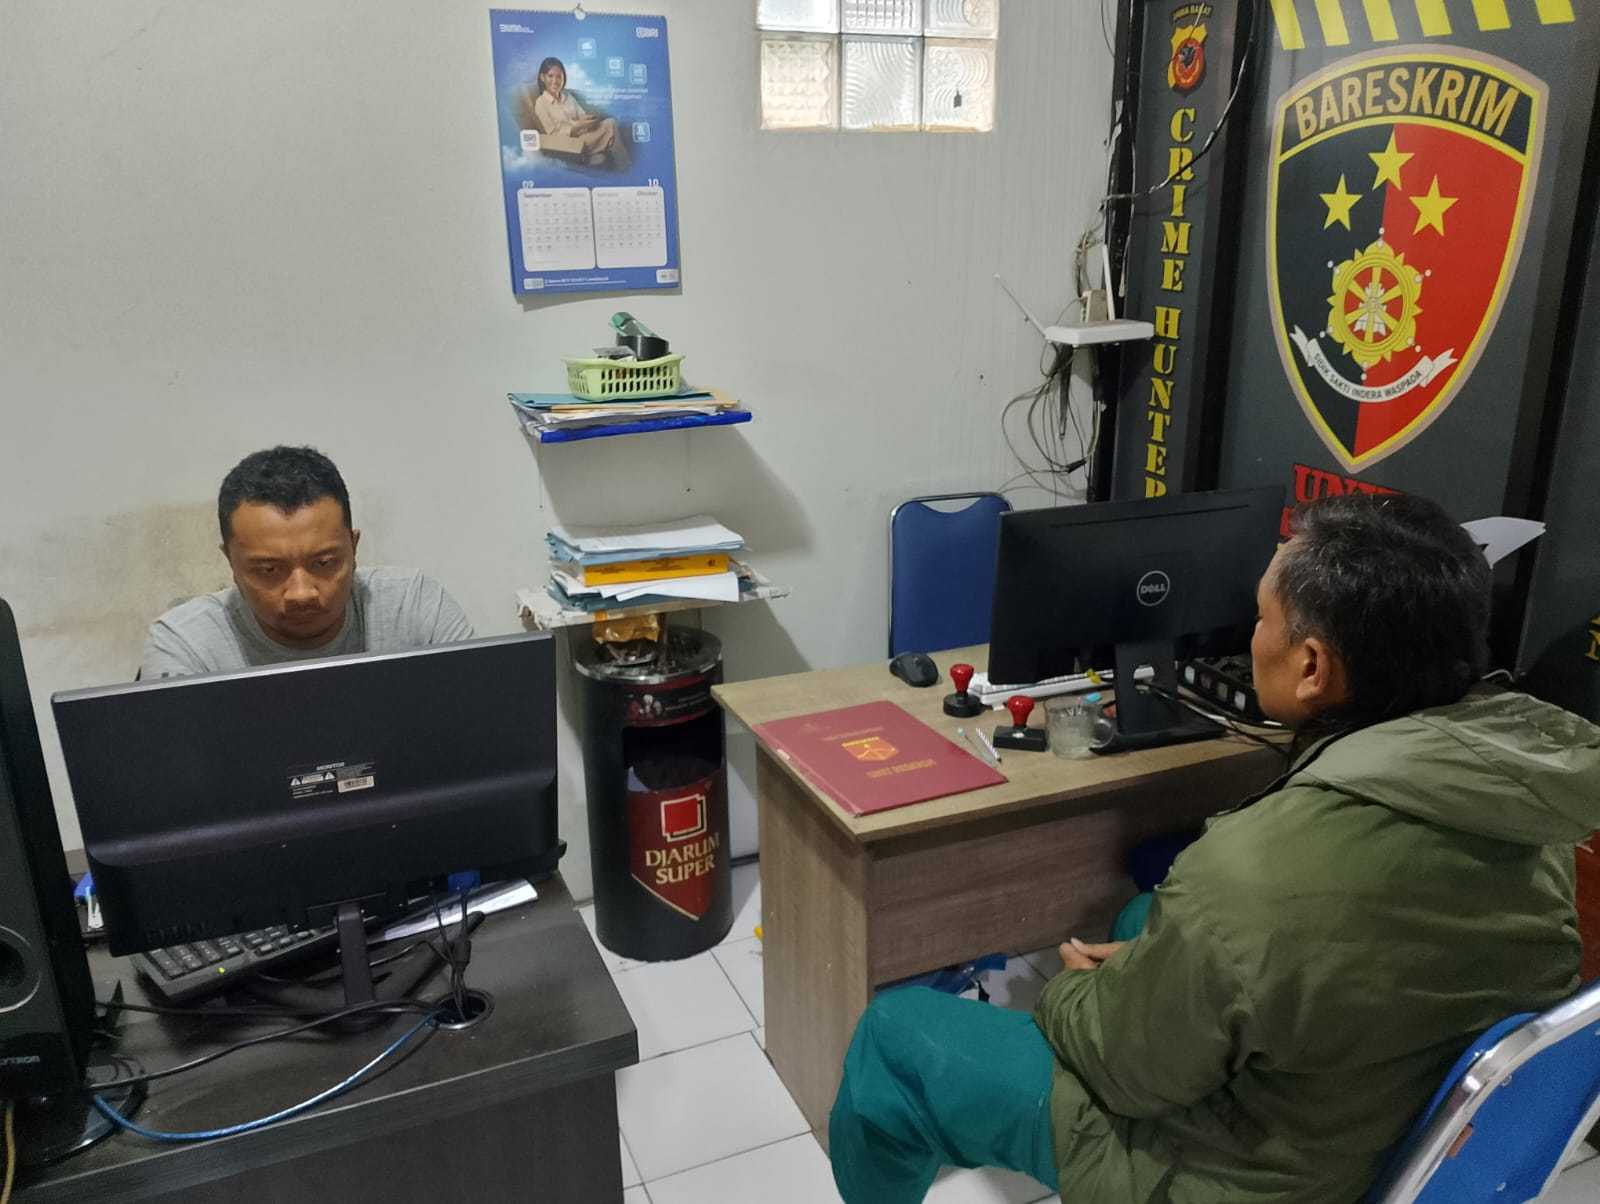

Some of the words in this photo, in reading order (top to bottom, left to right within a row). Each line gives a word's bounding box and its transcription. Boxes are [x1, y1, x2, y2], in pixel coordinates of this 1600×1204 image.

[1295, 67, 1521, 139] BARESKRIM
[1160, 107, 1196, 292] CRIME
[1384, 370, 1423, 397] WASPADA
[656, 854, 715, 884] SUPER
